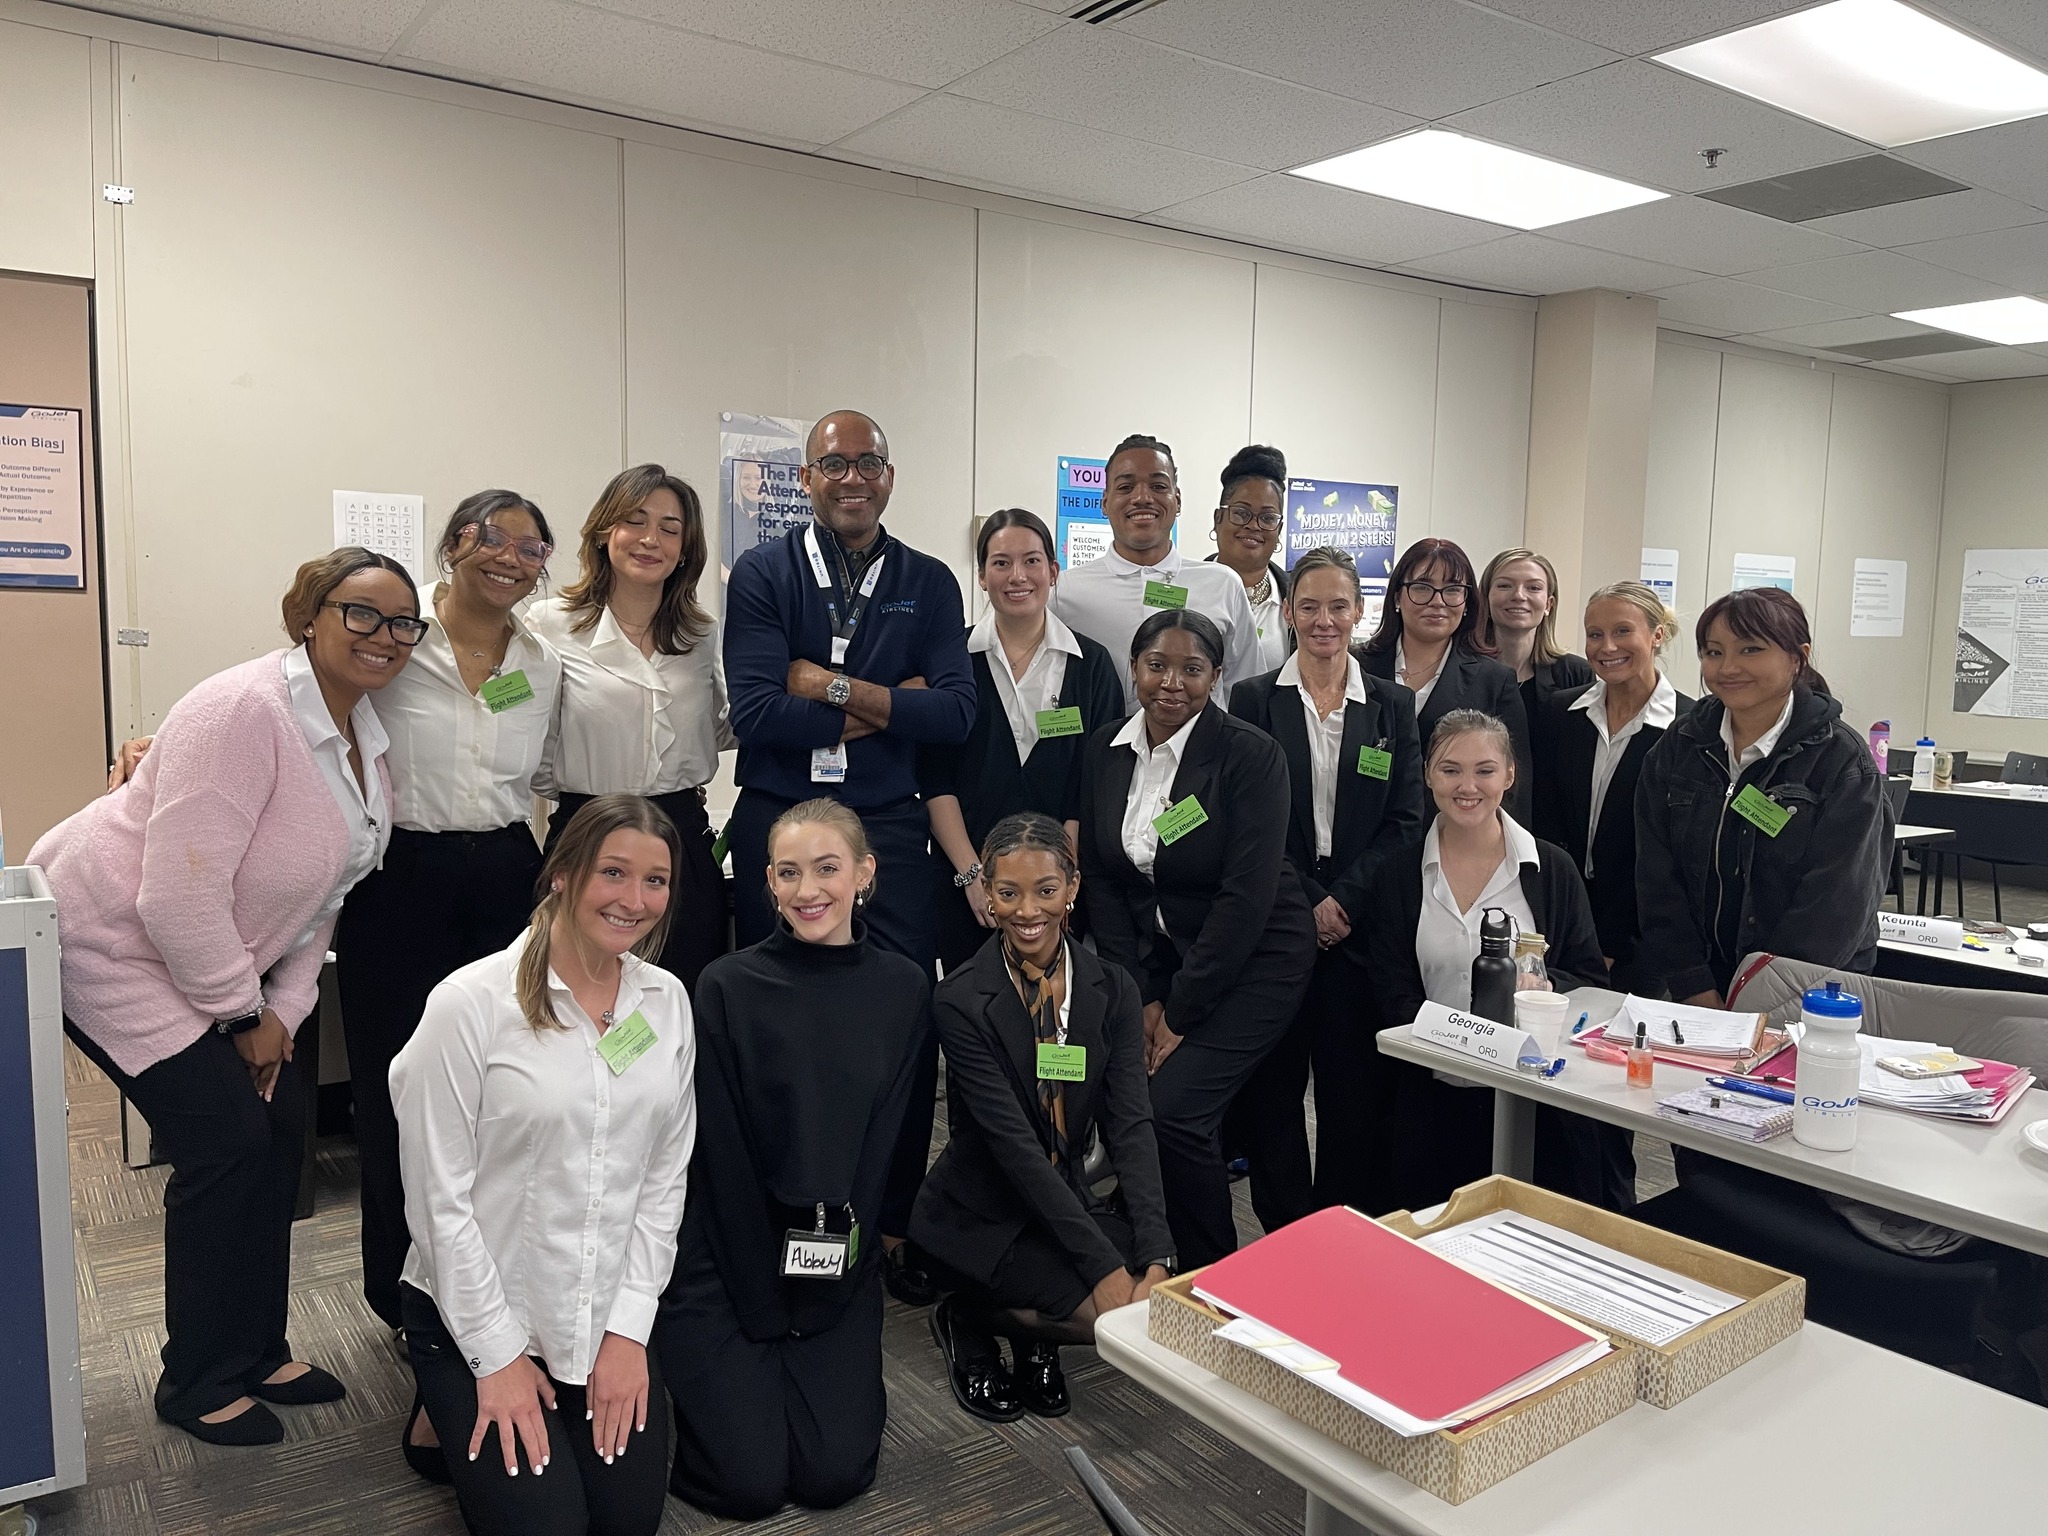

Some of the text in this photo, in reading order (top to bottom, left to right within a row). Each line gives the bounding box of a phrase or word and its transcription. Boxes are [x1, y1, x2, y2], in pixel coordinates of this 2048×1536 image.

[0, 435, 60, 449] tion Bias
[0, 463, 61, 473] Outcome Different
[757, 464, 786, 481] The
[1073, 469, 1101, 484] YOU
[0, 485, 8, 493] by
[10, 486, 46, 494] Experience
[1062, 496, 1080, 508] THE
[2, 507, 38, 515] Perception
[17, 515, 43, 523] Making
[757, 512, 780, 529] for
[1301, 512, 1388, 532] MONEY, MONEY,
[1072, 536, 1101, 545] WELCOME
[1291, 531, 1395, 550] MONEY IN 2 STEPS!
[23, 546, 65, 556] Experiencing
[1072, 544, 1106, 552] CUSTOMERS
[1081, 552, 1096, 560] THEY
[490, 689, 532, 711] Flight Attendant
[1040, 724, 1082, 736] Flight Attendant
[1734, 799, 1777, 834] Flight Attendant
[1163, 812, 1205, 842] Flight Attendant
[1882, 914, 1927, 928] Keunta
[1917, 934, 1938, 944] ORD
[1447, 1012, 1496, 1036] Georgia
[1430, 1029, 1459, 1040] GoJet
[1478, 1045, 1498, 1058] ORD
[1039, 1066, 1084, 1078] Flight Attendant
[791, 1246, 842, 1275] Abbey
